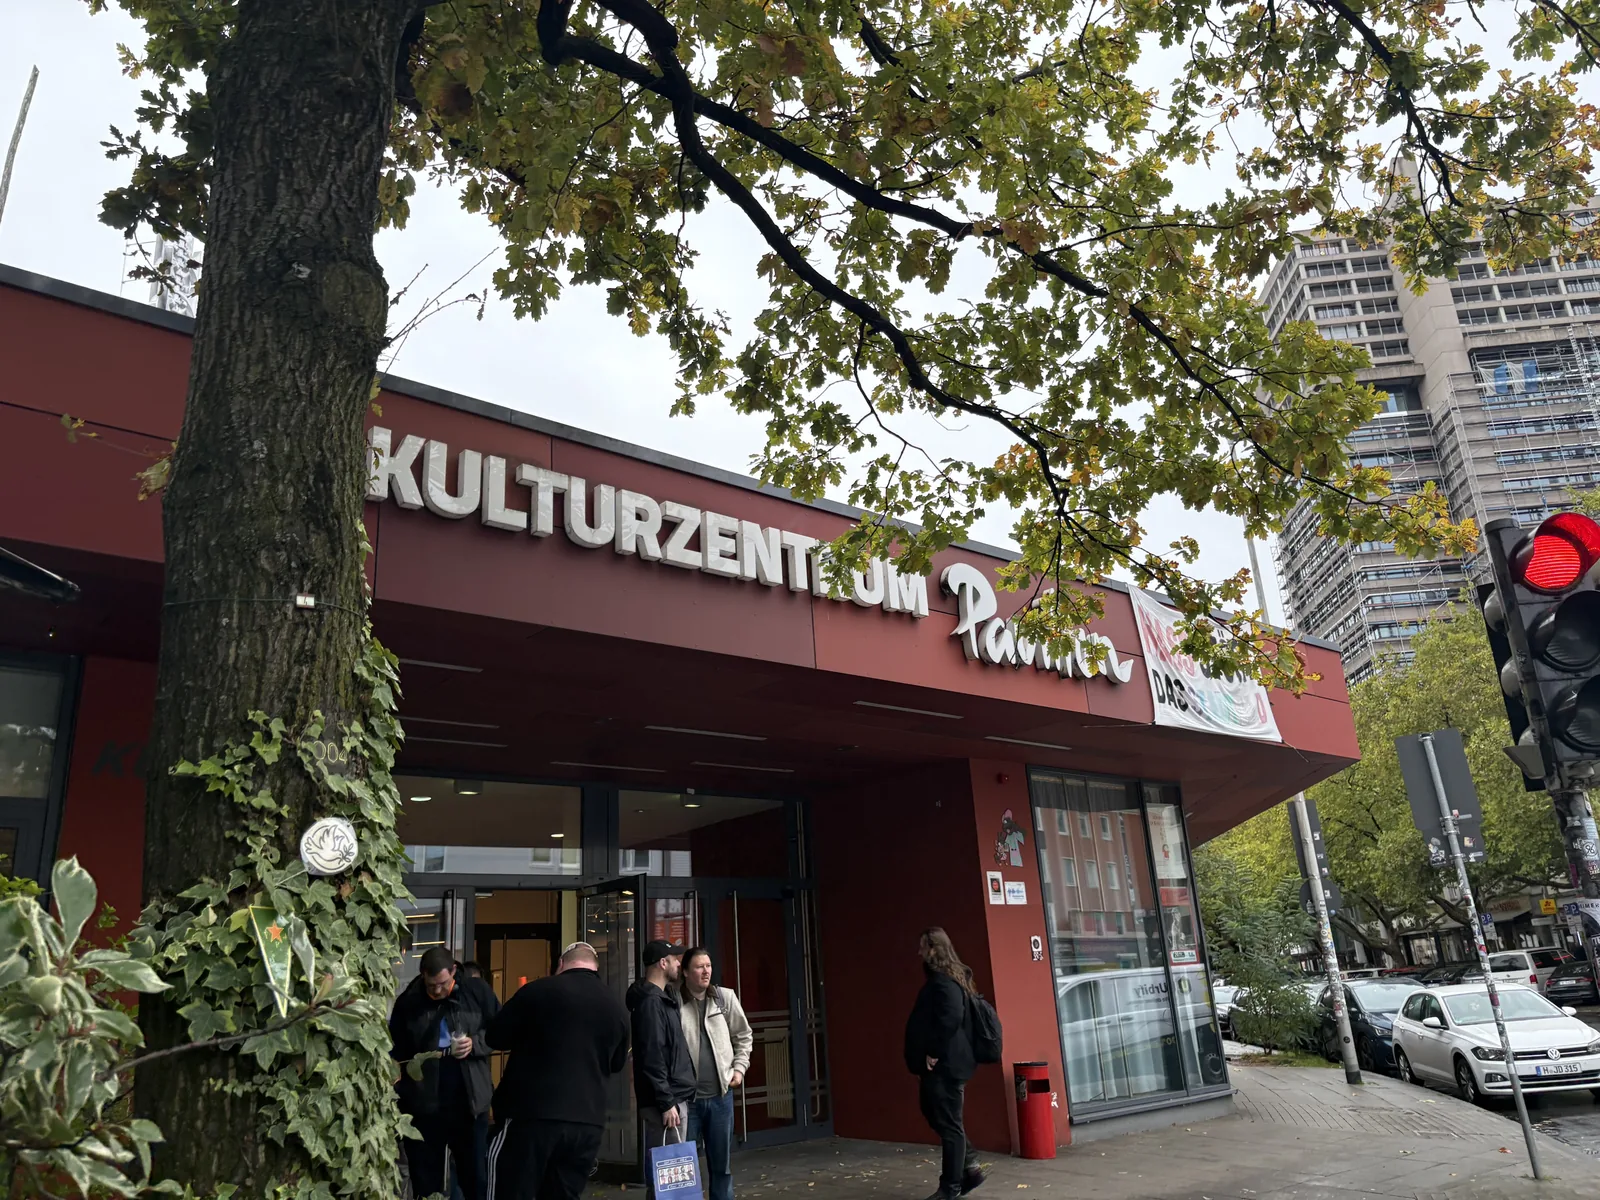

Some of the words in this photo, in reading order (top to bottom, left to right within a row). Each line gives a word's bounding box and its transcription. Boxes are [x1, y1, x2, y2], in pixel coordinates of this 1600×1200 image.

[1152, 669, 1189, 712] DAS
[1543, 1067, 1549, 1075] H
[1564, 1064, 1578, 1073] 315
